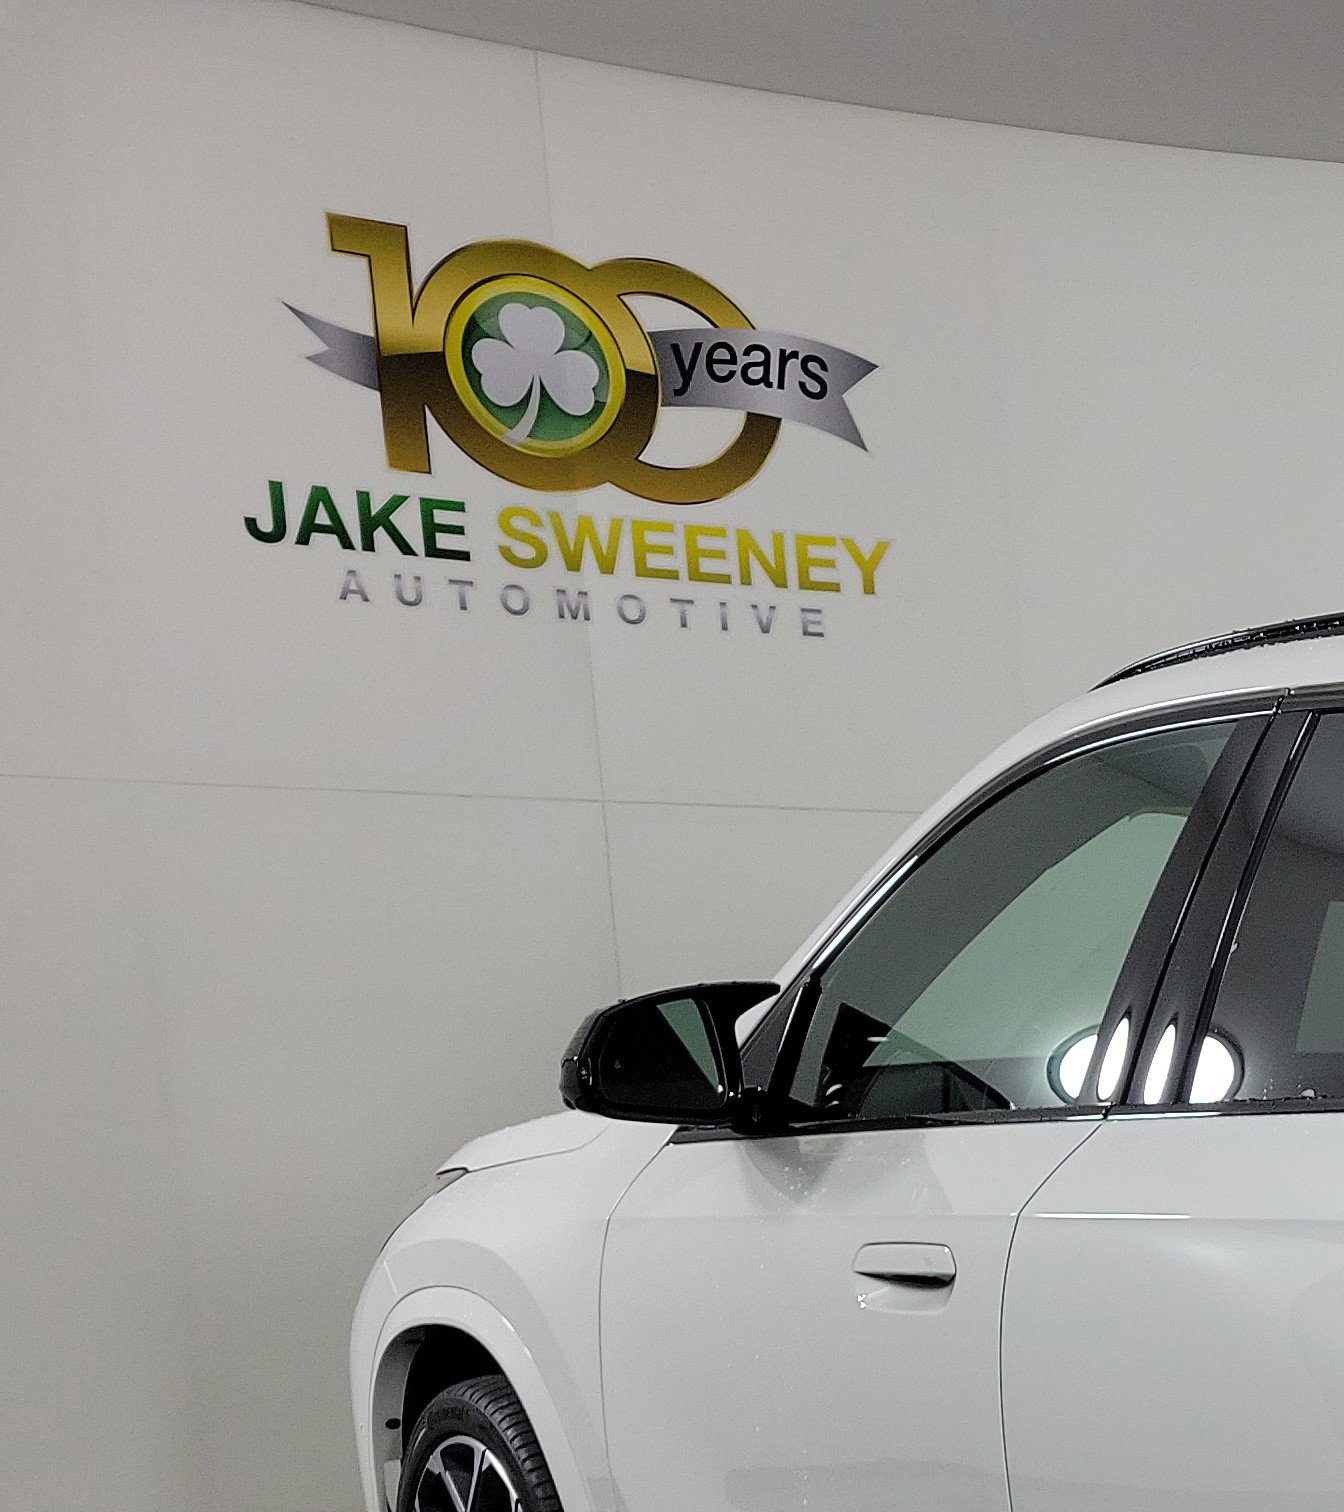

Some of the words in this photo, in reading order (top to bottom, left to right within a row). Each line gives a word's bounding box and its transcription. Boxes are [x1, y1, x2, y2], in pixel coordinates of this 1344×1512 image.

[325, 212, 782, 503] 100
[670, 341, 830, 401] years
[244, 479, 471, 562] JAKE
[497, 505, 891, 596] SWEENEY
[339, 569, 825, 638] AUTOMOTIVE
